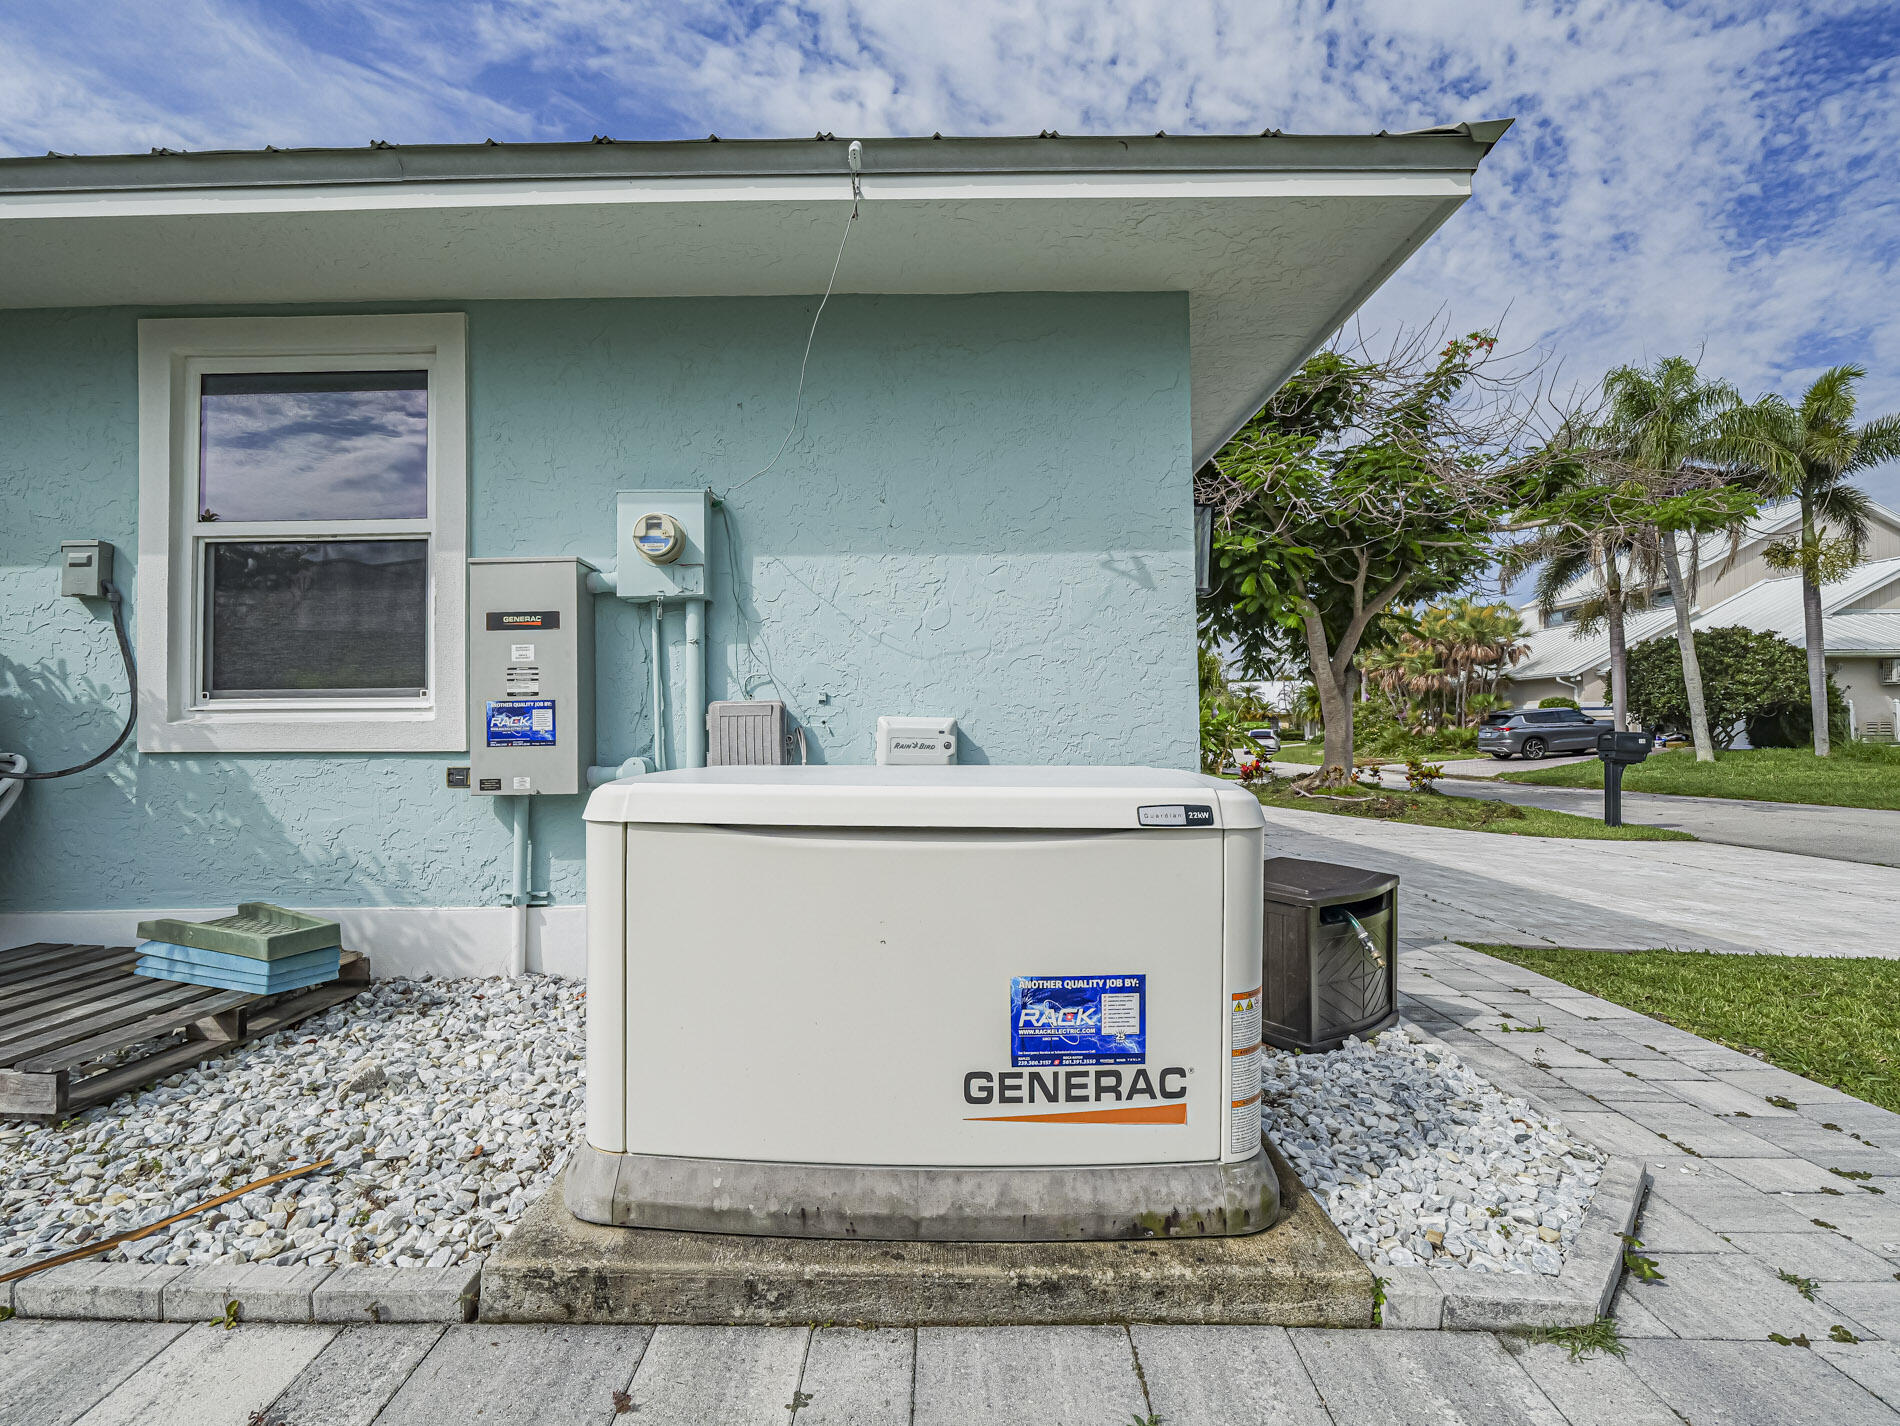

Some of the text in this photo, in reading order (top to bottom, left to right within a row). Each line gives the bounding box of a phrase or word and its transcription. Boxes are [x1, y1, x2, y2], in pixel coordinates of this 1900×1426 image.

[490, 716, 530, 727] RACK
[1019, 979, 1139, 989] ANOTHER QUALITY JOB BY:
[1019, 1008, 1096, 1026] RACK
[963, 1067, 1187, 1105] GENERAC
